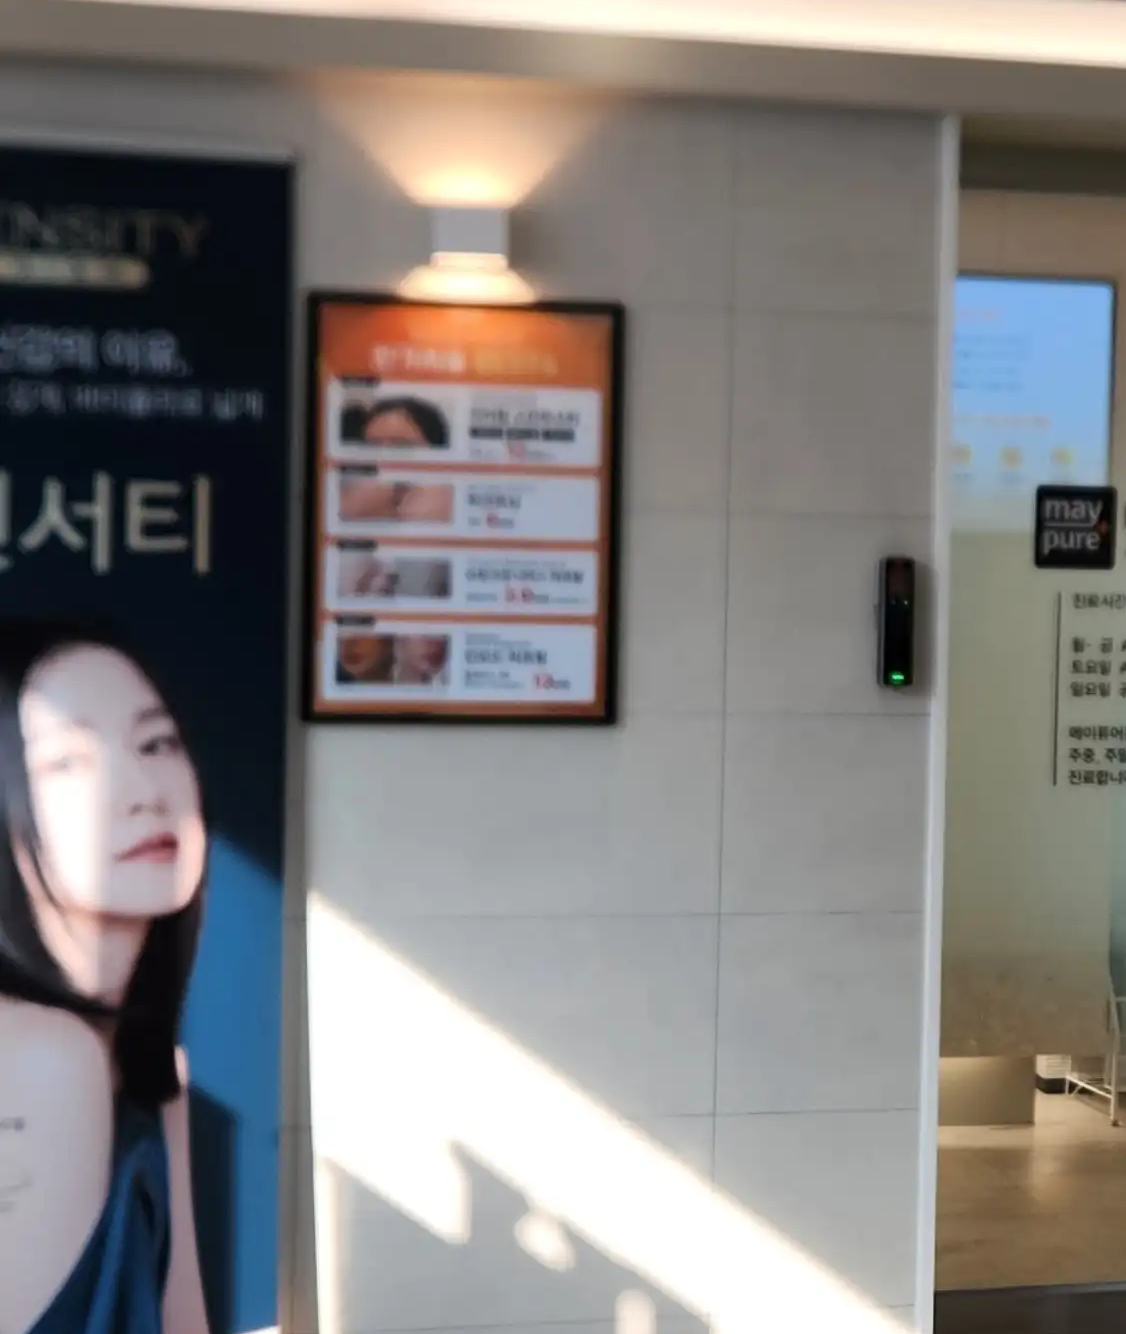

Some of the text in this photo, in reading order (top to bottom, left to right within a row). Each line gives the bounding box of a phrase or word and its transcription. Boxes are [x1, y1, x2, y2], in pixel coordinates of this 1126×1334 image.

[1043, 497, 1104, 527] may
[1042, 528, 1101, 554] pure
[1071, 659, 1112, 676] 토요일
[1070, 681, 1111, 698] 일요일
